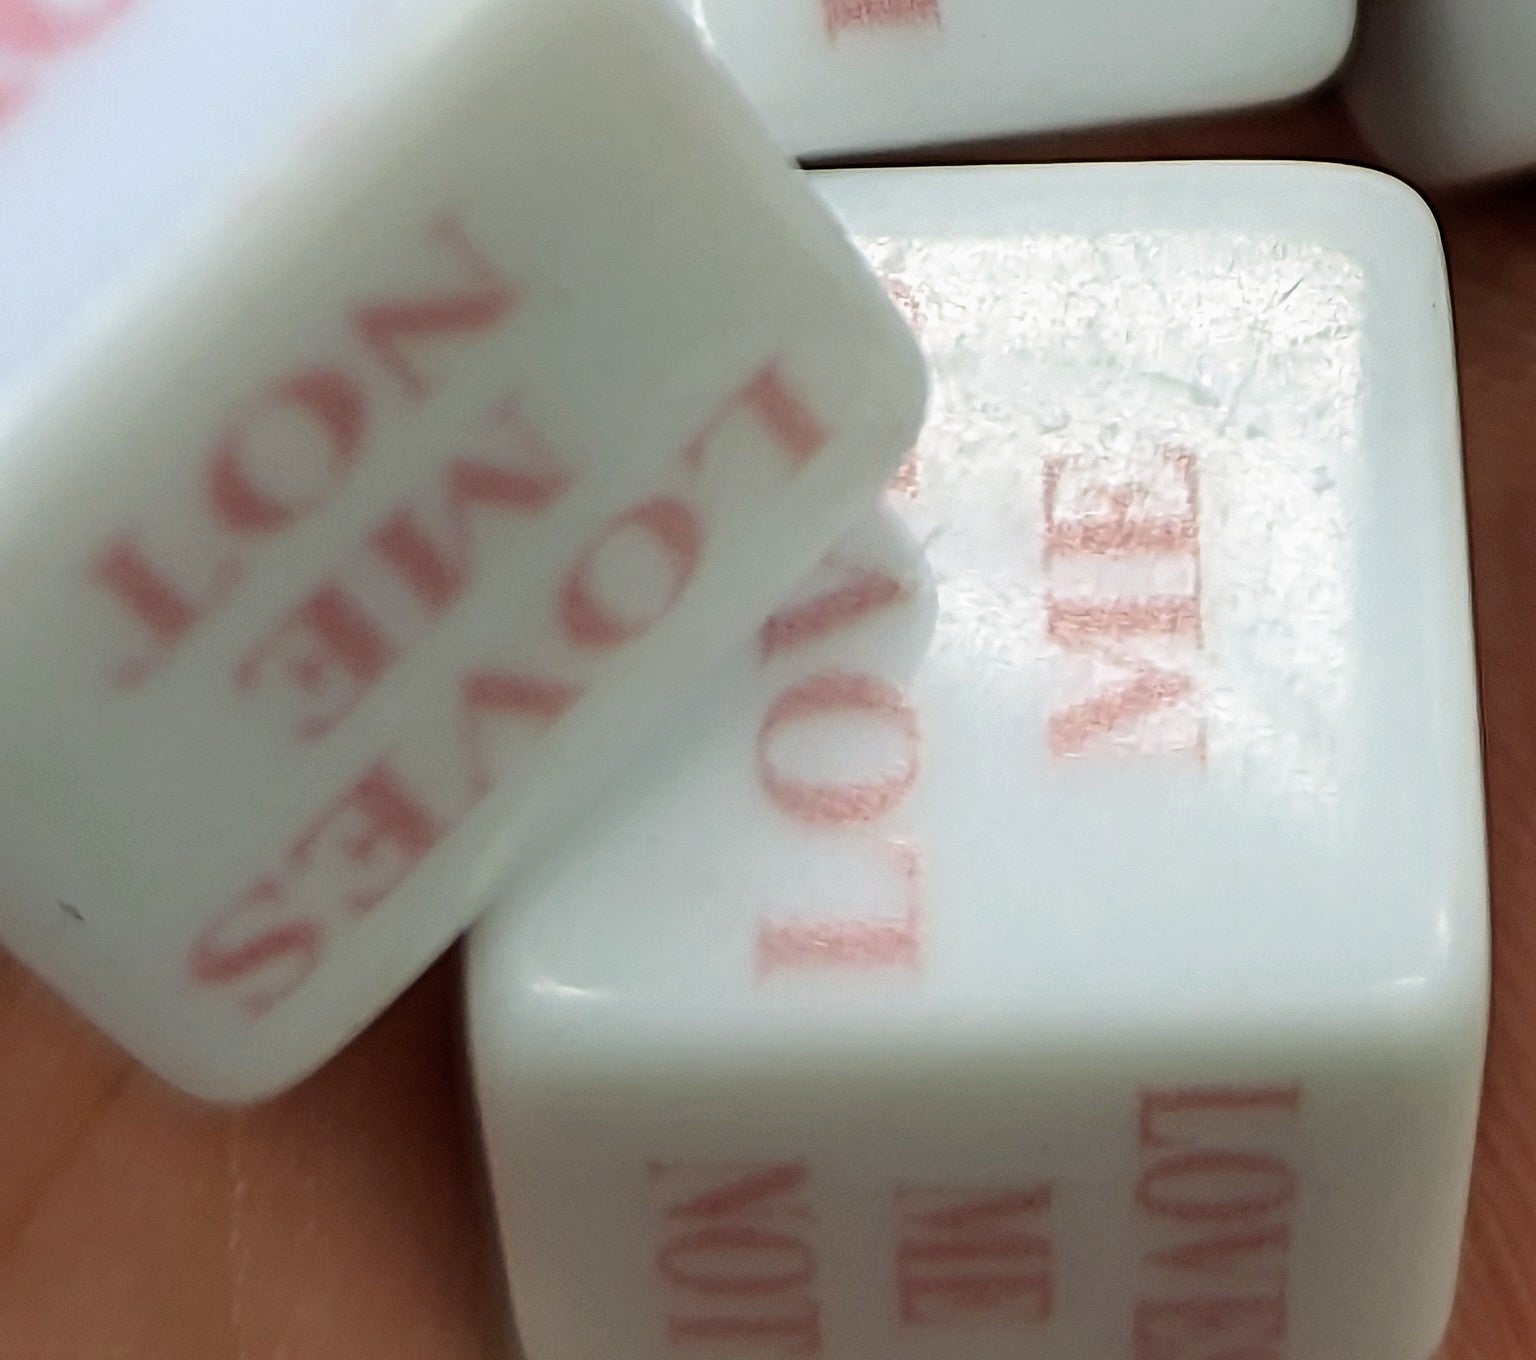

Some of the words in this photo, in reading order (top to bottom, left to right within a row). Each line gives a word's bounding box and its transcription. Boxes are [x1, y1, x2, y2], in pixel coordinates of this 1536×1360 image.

[91, 213, 521, 694] NOT
[228, 389, 572, 746] ME
[1041, 445, 1207, 766] ME
[185, 350, 839, 1025] LOVES
[647, 1155, 822, 1356] NOT
[893, 1178, 1055, 1328] ME
[1132, 1080, 1303, 1360] LOVE
